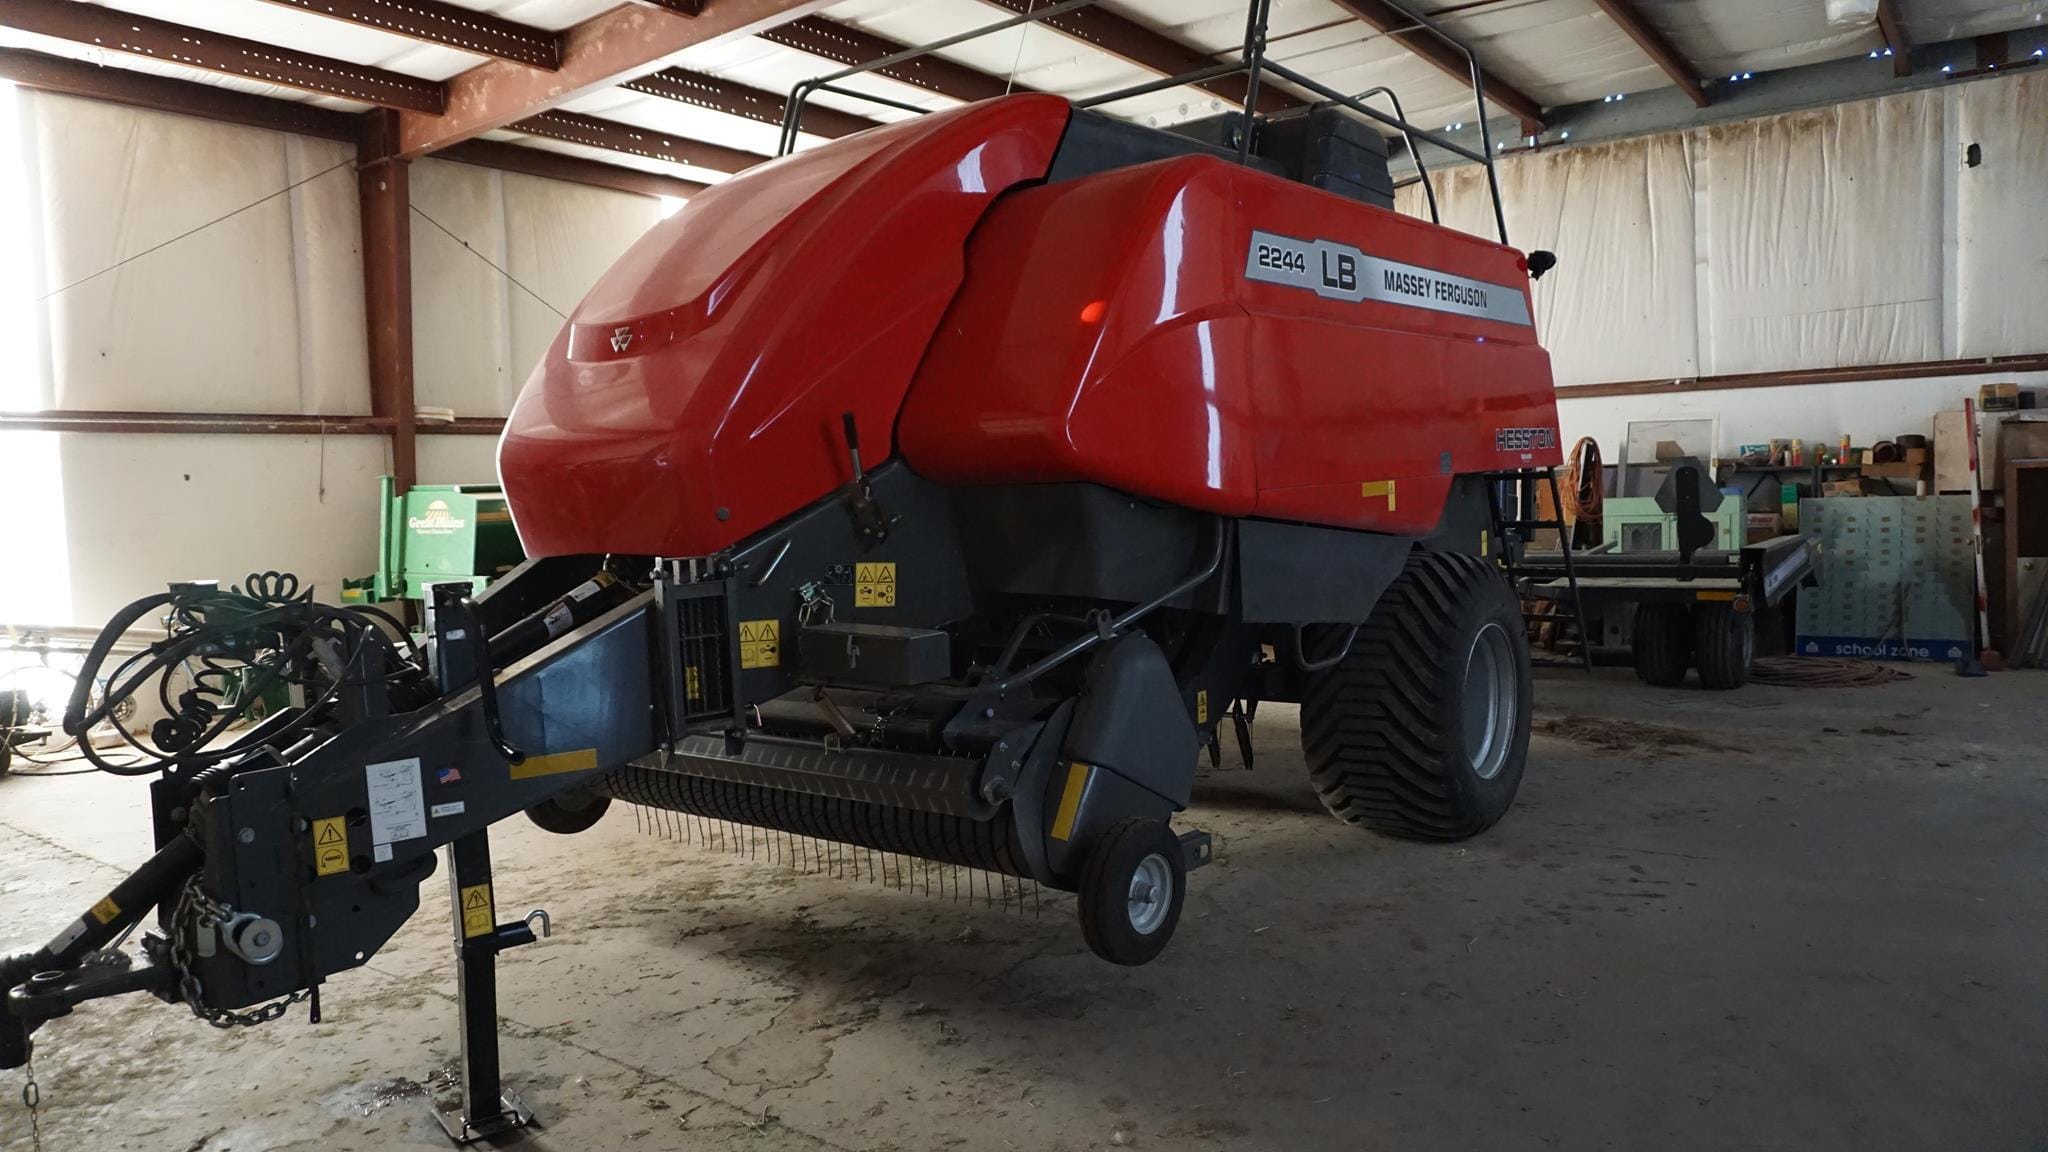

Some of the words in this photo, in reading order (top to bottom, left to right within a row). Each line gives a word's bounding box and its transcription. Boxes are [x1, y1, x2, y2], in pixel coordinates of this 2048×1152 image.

[1258, 244, 1306, 274] 2244
[1321, 249, 1357, 291] LB
[1383, 268, 1432, 299] MASSEY
[1434, 280, 1488, 309] FERGUSON
[1495, 427, 1556, 451] HESSTON
[1834, 643, 1887, 656] school
[1890, 646, 1930, 657] zone
